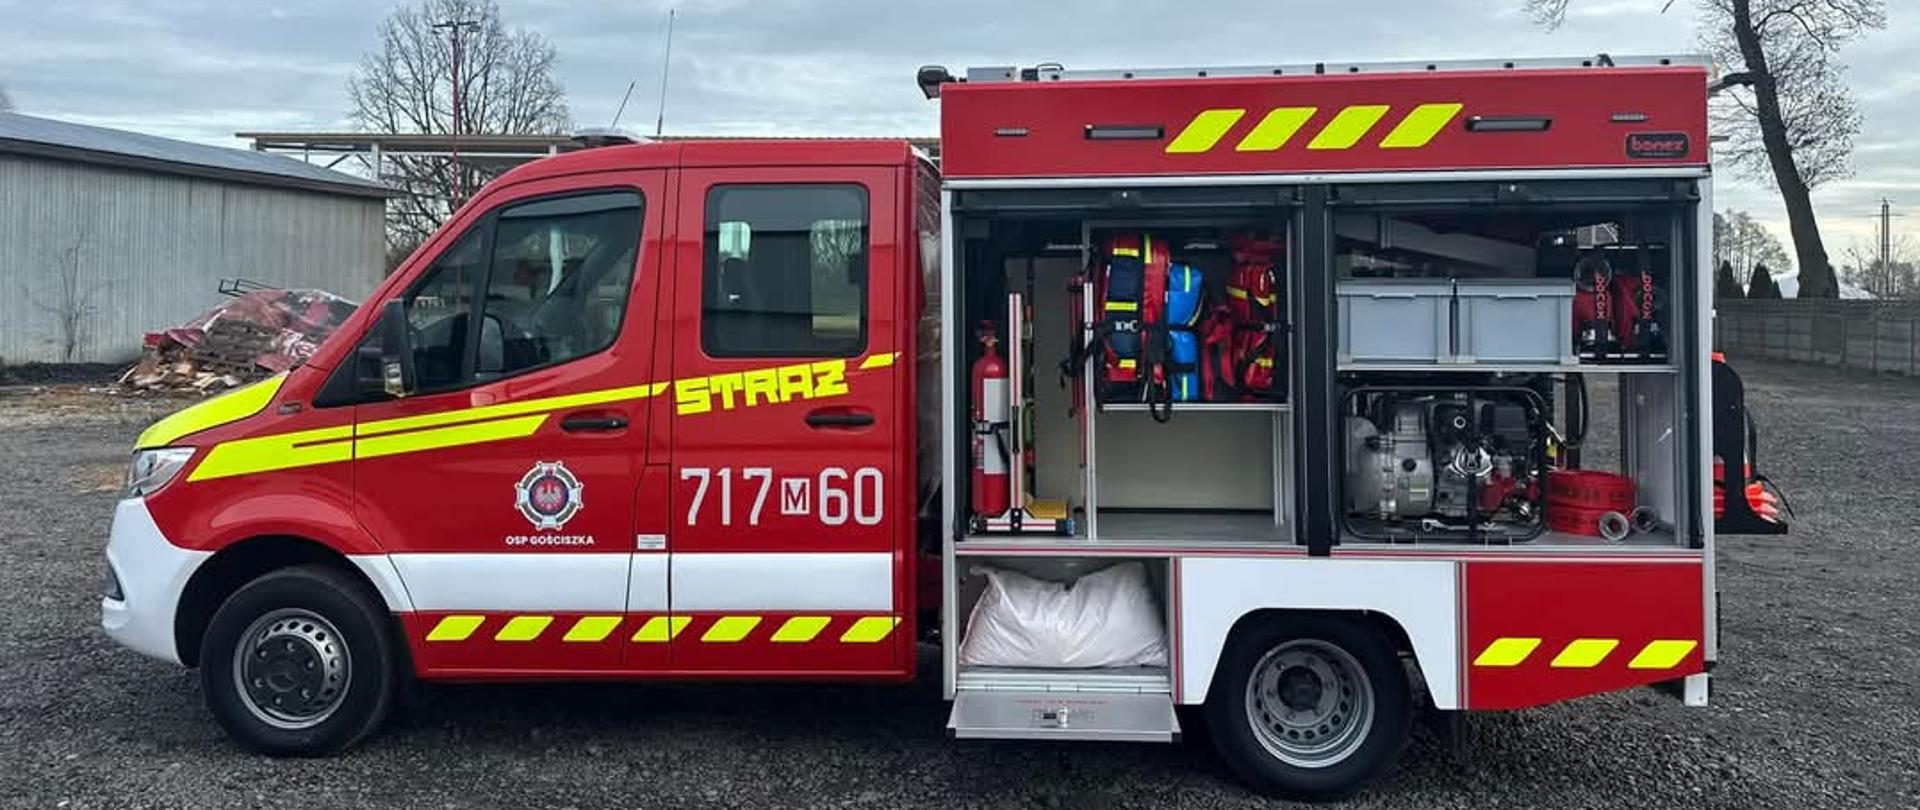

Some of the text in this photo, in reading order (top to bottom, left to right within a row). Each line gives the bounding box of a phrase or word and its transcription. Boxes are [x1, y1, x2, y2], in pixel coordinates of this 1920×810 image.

[680, 467, 883, 526] 717 M 60
[505, 535, 528, 545] OSP
